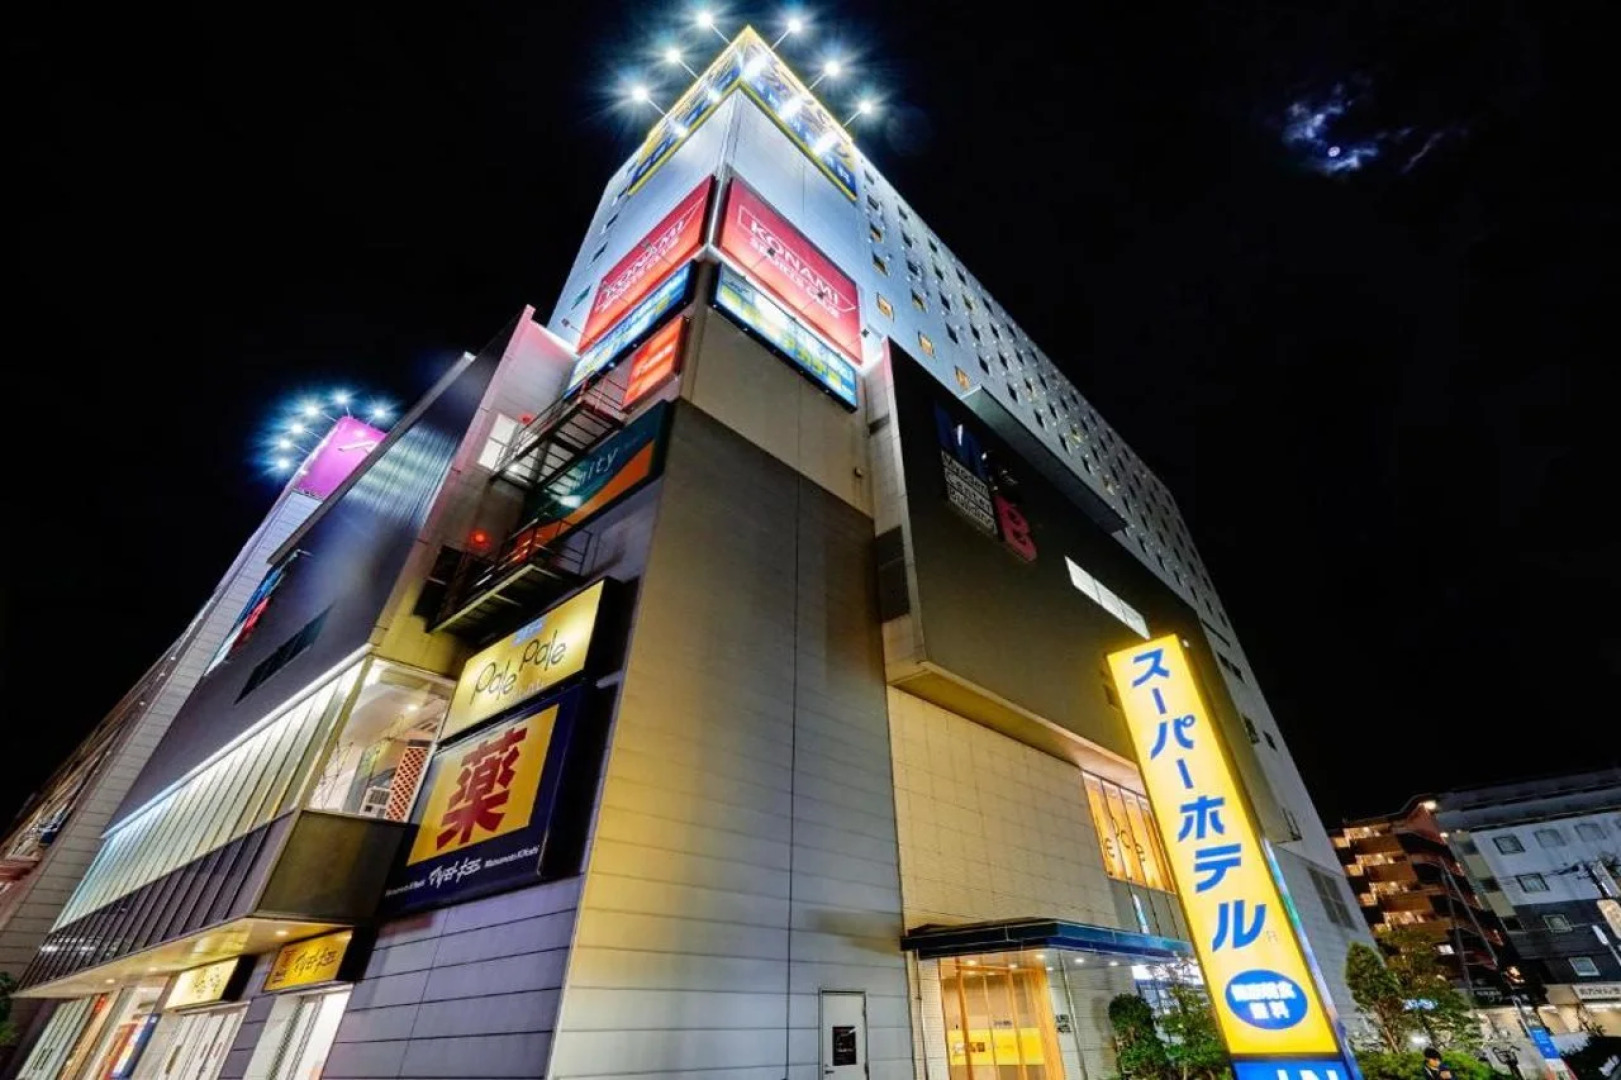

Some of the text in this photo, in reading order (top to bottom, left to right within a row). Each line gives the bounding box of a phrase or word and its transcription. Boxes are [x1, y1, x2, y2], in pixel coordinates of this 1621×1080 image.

[750, 219, 838, 305] KONAMI
[436, 727, 528, 852] 薬
[1132, 648, 1268, 952] スーパーホテル
